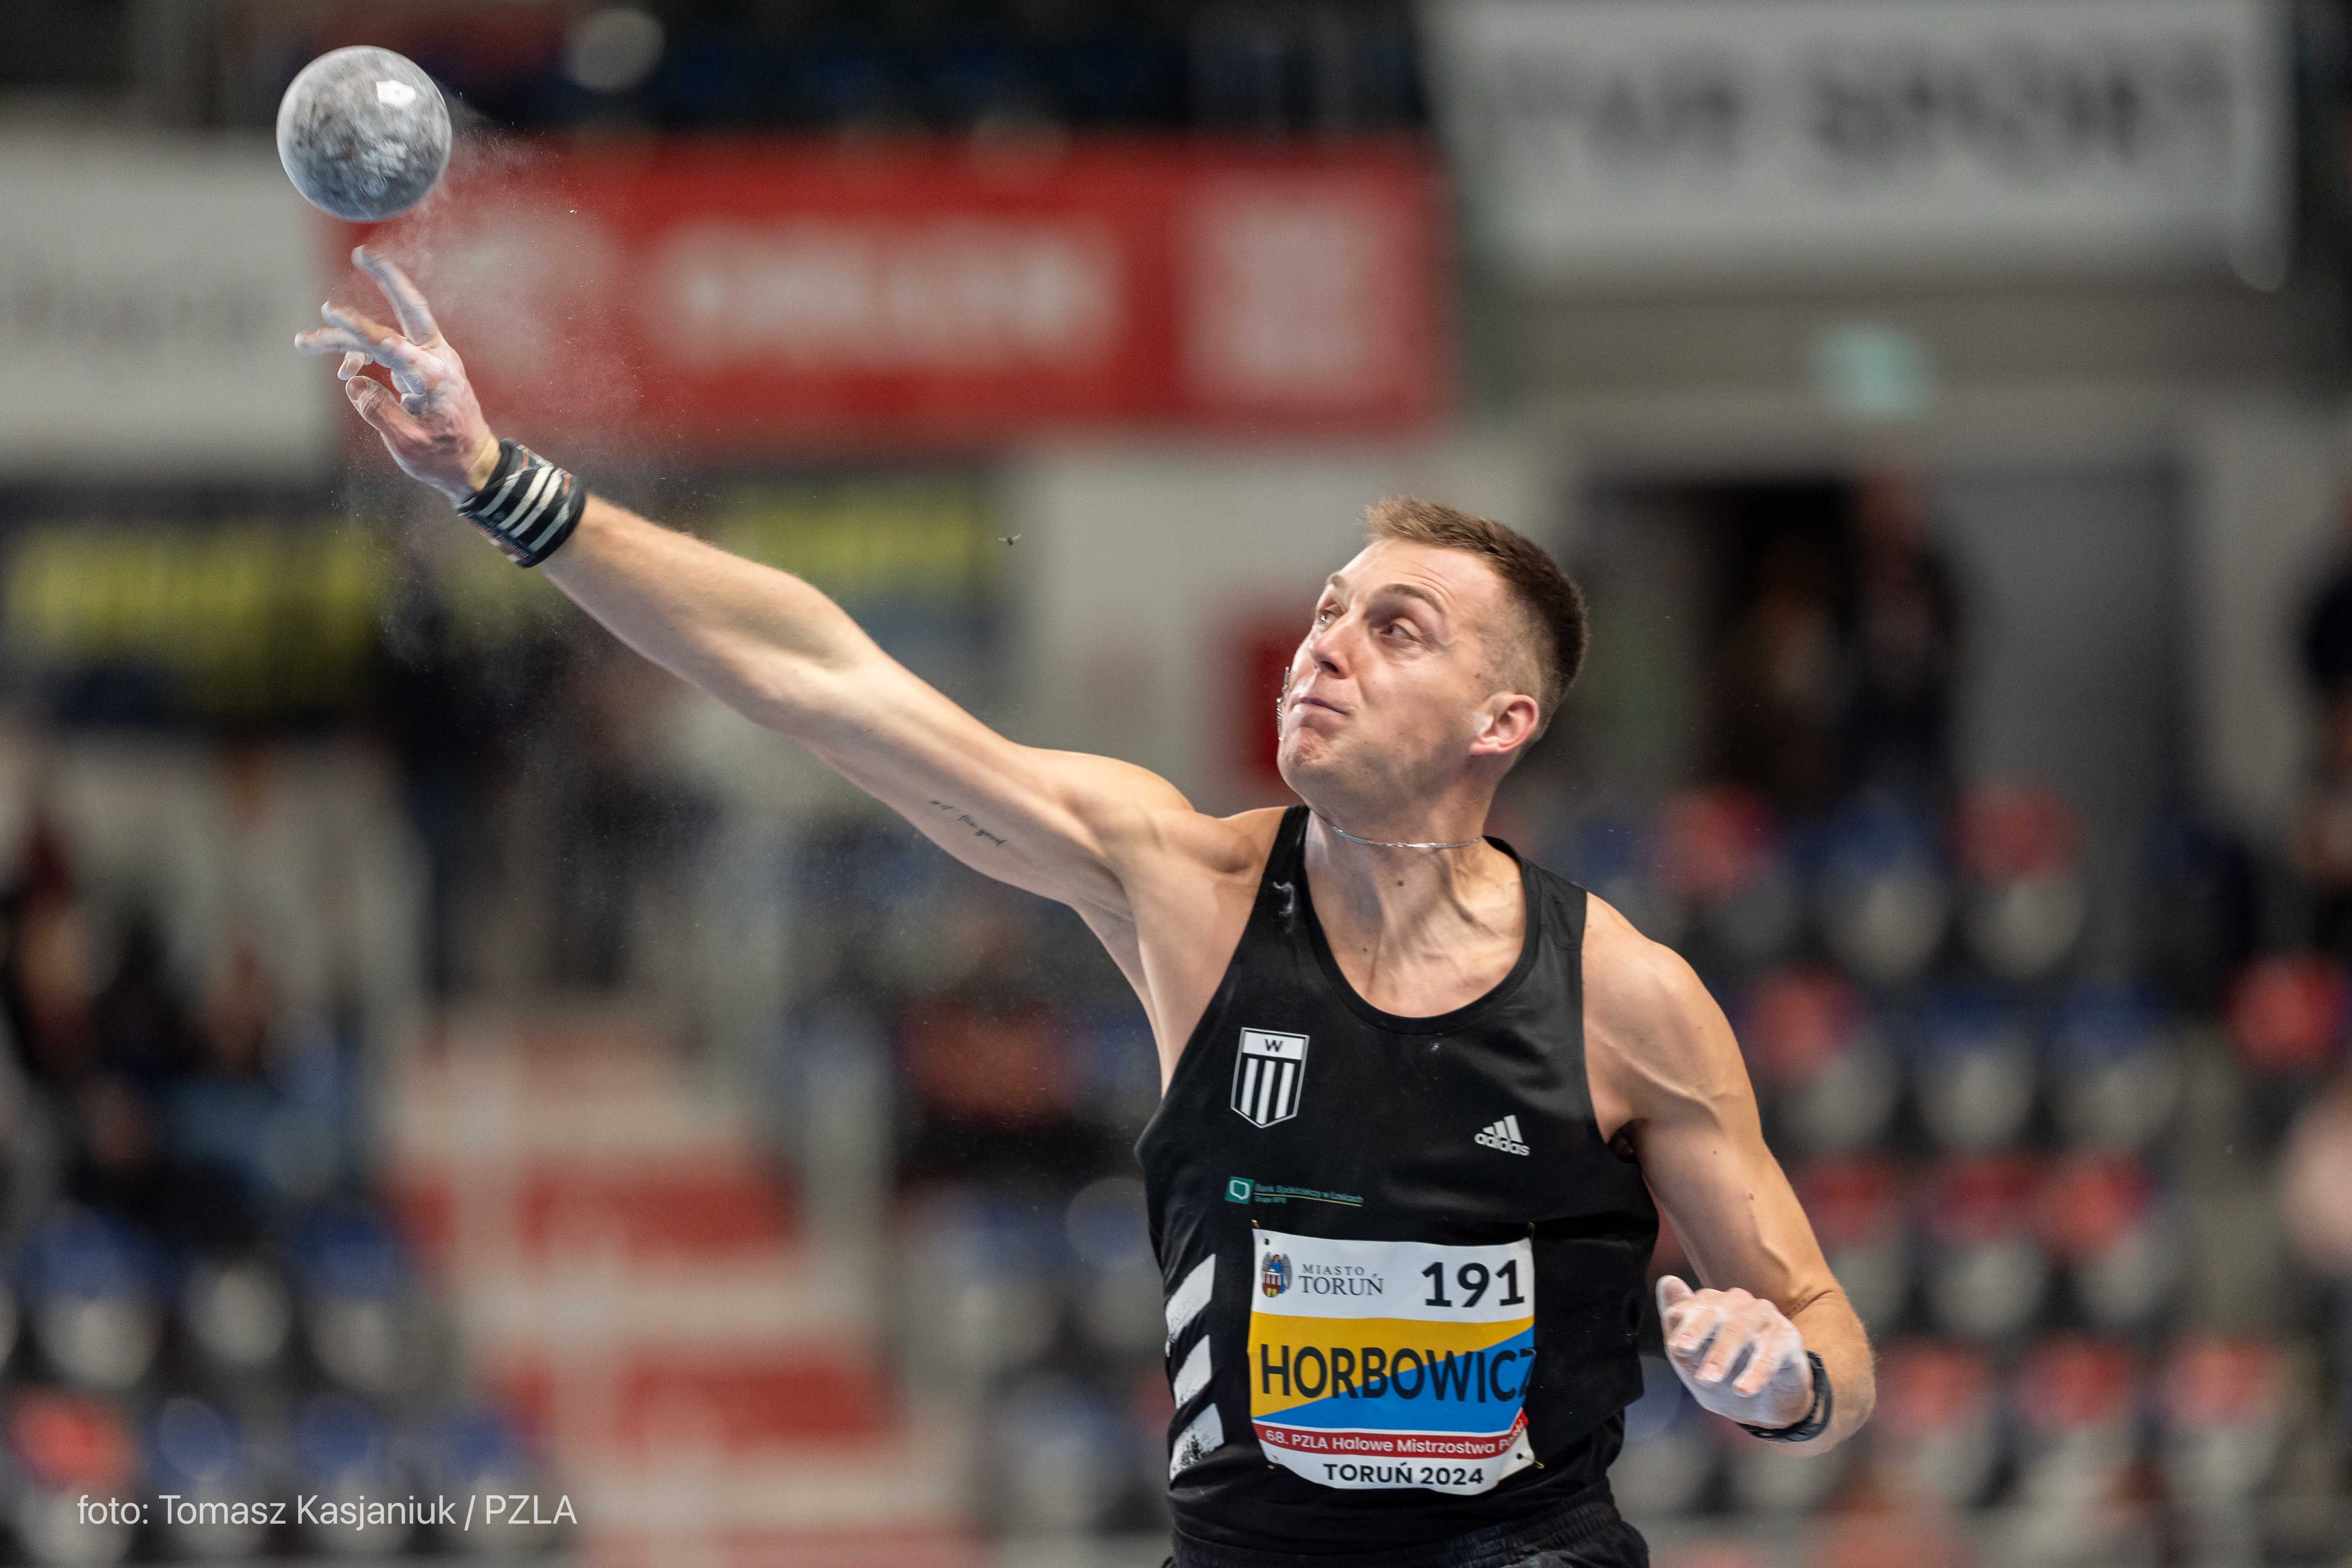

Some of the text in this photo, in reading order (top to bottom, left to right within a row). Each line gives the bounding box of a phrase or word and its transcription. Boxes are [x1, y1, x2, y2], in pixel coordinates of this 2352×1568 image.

[1264, 1039, 1284, 1052] W
[1474, 1133, 1530, 1156] adidas
[1302, 1264, 1365, 1276] MIASTO
[1298, 1273, 1384, 1295] TORUŃ
[1422, 1259, 1525, 1307] 191
[1265, 1429, 1289, 1444] 68.
[1292, 1434, 1328, 1449] PZLA
[1332, 1437, 1393, 1452] Halowe
[1397, 1439, 1495, 1454] Mistrzostwa
[1323, 1462, 1484, 1485] TORUŃ 2024
